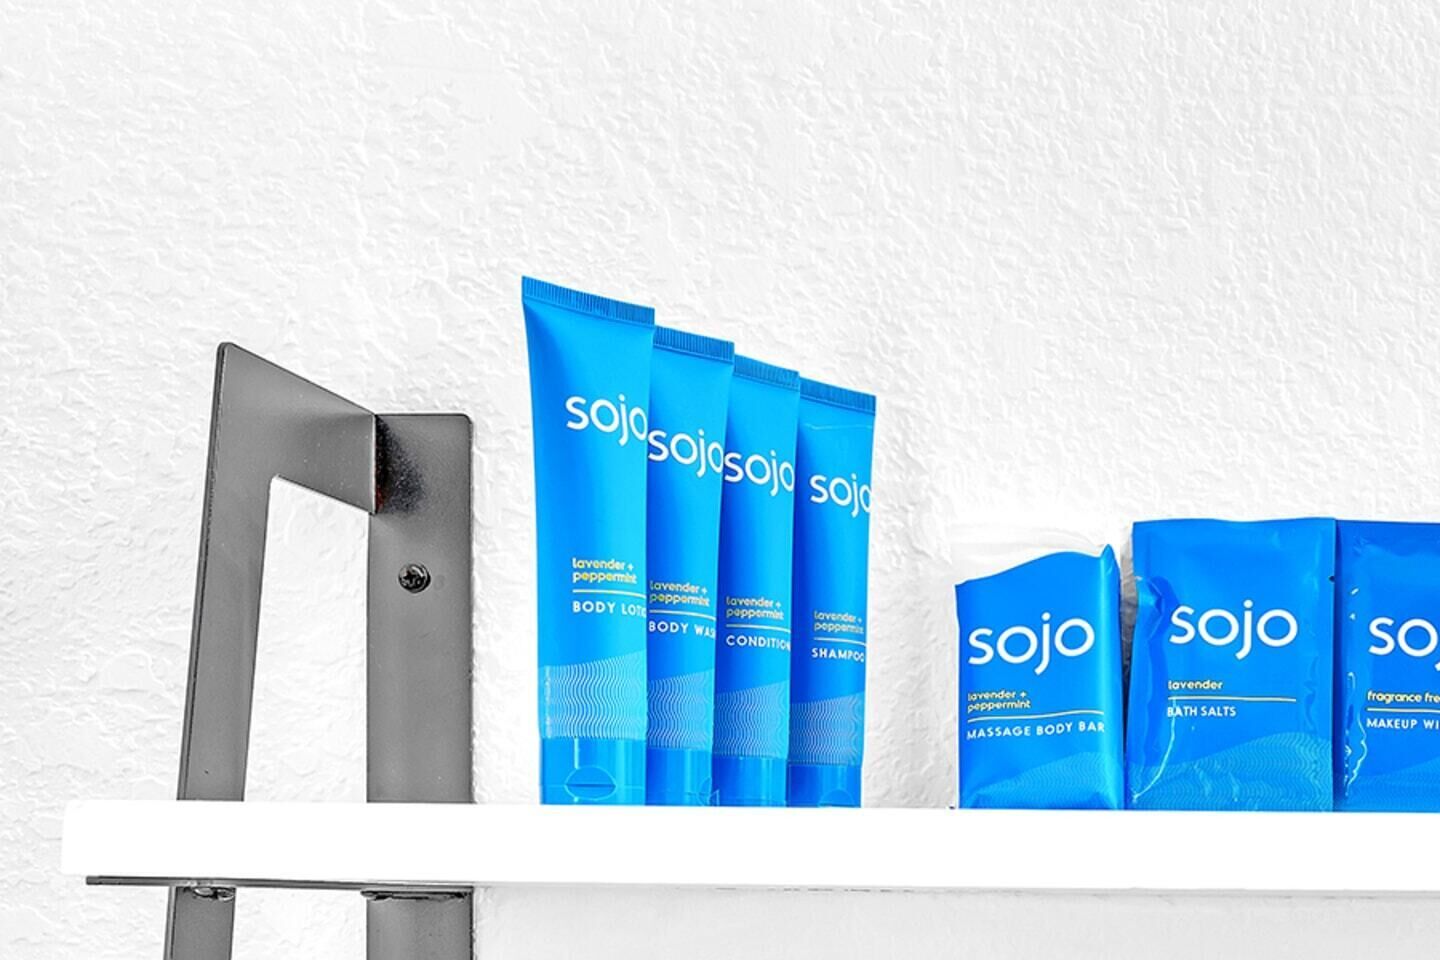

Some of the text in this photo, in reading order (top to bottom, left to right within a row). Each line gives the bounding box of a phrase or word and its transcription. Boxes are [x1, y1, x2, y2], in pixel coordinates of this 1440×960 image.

[565, 394, 648, 446] sojo
[647, 428, 724, 478] sojo
[723, 450, 795, 497] sojo
[809, 473, 872, 517] sojo
[572, 557, 626, 571] lavender
[572, 571, 637, 584] peppermint
[650, 580, 699, 594] lavender
[649, 593, 710, 607] peppermint
[726, 596, 773, 608] lavender
[572, 601, 615, 614] BODY
[726, 607, 784, 620] peppermint
[814, 610, 857, 623] lavender
[648, 621, 689, 634] BODY
[814, 622, 865, 635] peppermint
[1169, 599, 1298, 660] sojo
[968, 612, 1095, 675] sojo
[1168, 680, 1223, 691] lavender
[967, 690, 1017, 702] lavender
[1367, 690, 1422, 705] fragrance
[967, 699, 1031, 714] peppermint
[1166, 706, 1237, 718] BATH SALTS
[966, 721, 1105, 741] MASSAGE BODY BAR
[1366, 718, 1418, 730] MAKEUP
